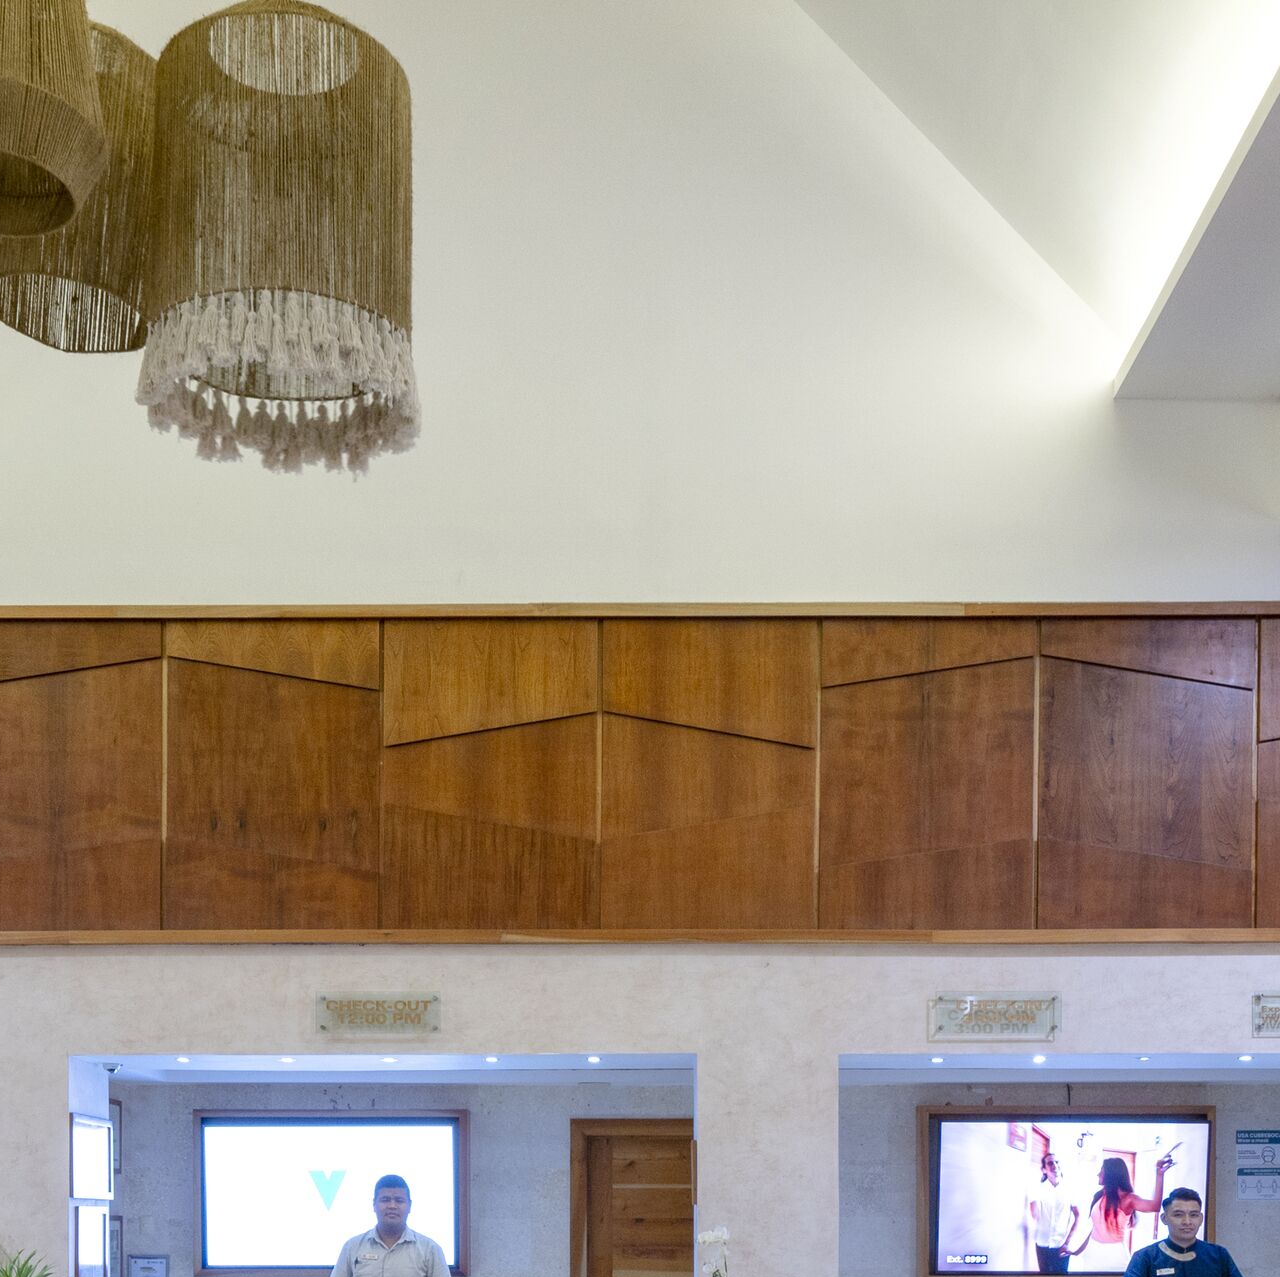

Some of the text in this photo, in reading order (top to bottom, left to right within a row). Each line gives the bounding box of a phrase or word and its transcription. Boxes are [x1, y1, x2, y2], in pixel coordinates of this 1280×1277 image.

[326, 1000, 432, 1012] CHECK-OUT
[338, 1013, 422, 1024] 12:00 PM
[965, 1255, 986, 1264] 8999
